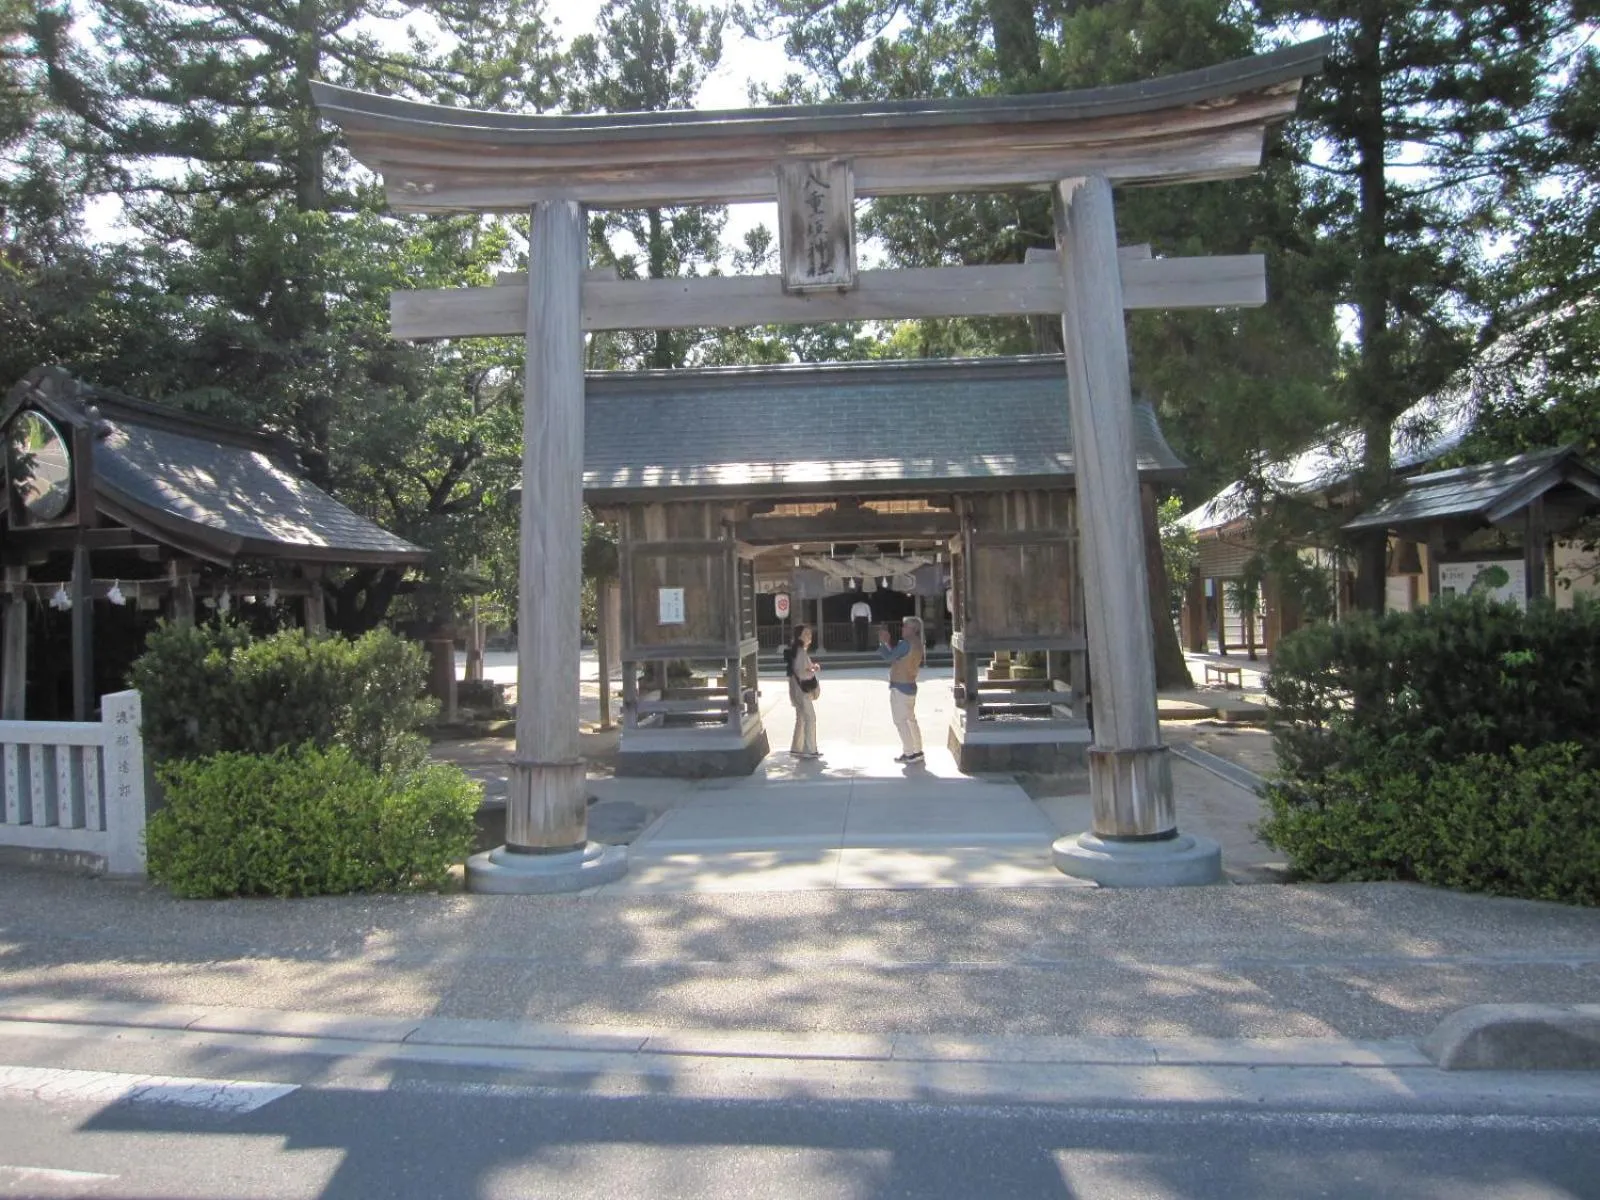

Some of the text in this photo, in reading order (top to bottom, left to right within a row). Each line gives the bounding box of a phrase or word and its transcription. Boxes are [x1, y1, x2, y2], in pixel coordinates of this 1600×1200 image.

[804, 173, 834, 278] 八重垣神社
